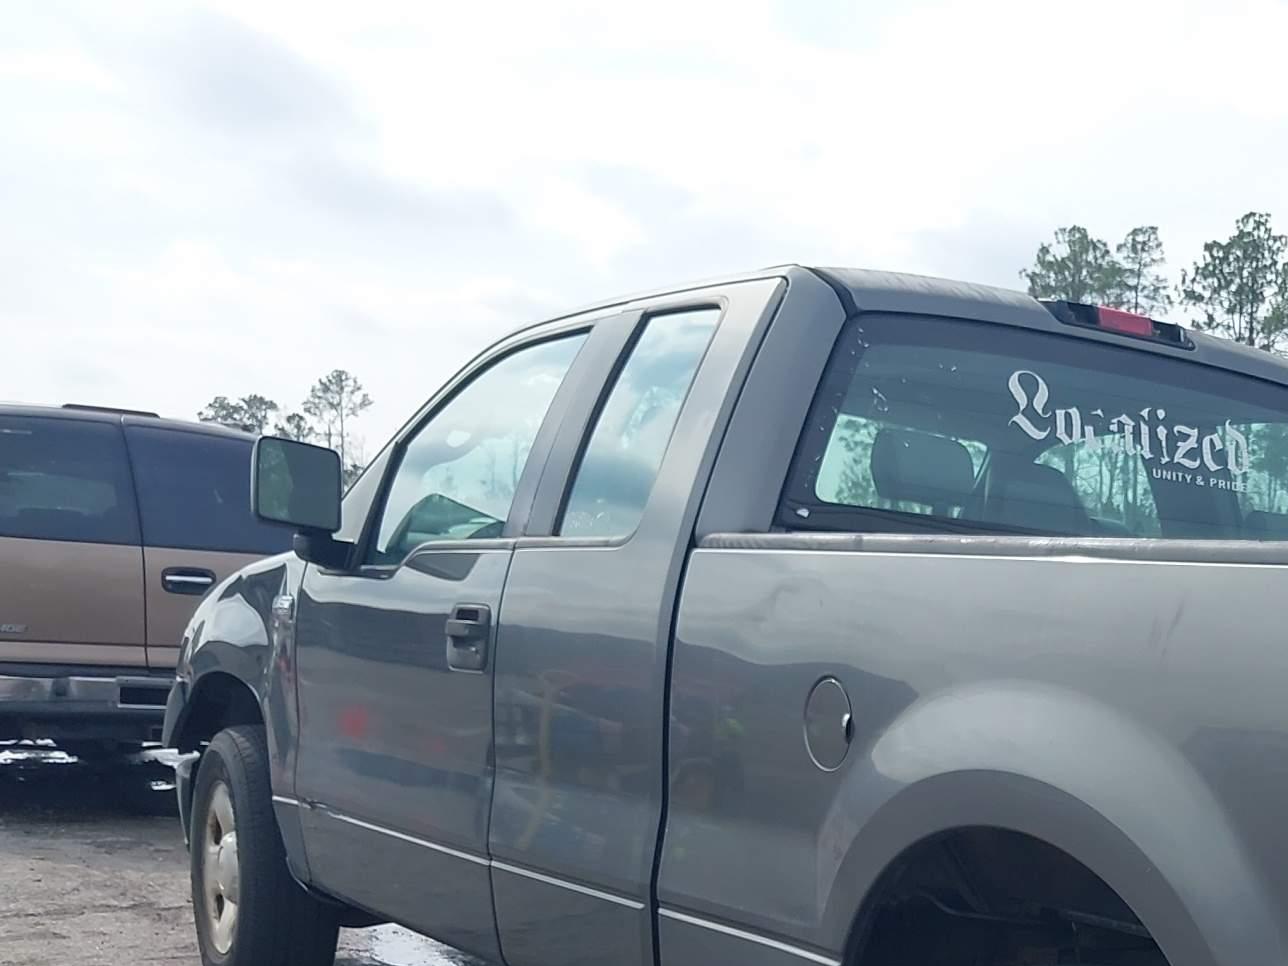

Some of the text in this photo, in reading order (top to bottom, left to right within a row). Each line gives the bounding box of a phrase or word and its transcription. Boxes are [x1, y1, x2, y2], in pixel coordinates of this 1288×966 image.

[1152, 467, 1248, 494] UNITY & PRIDE
